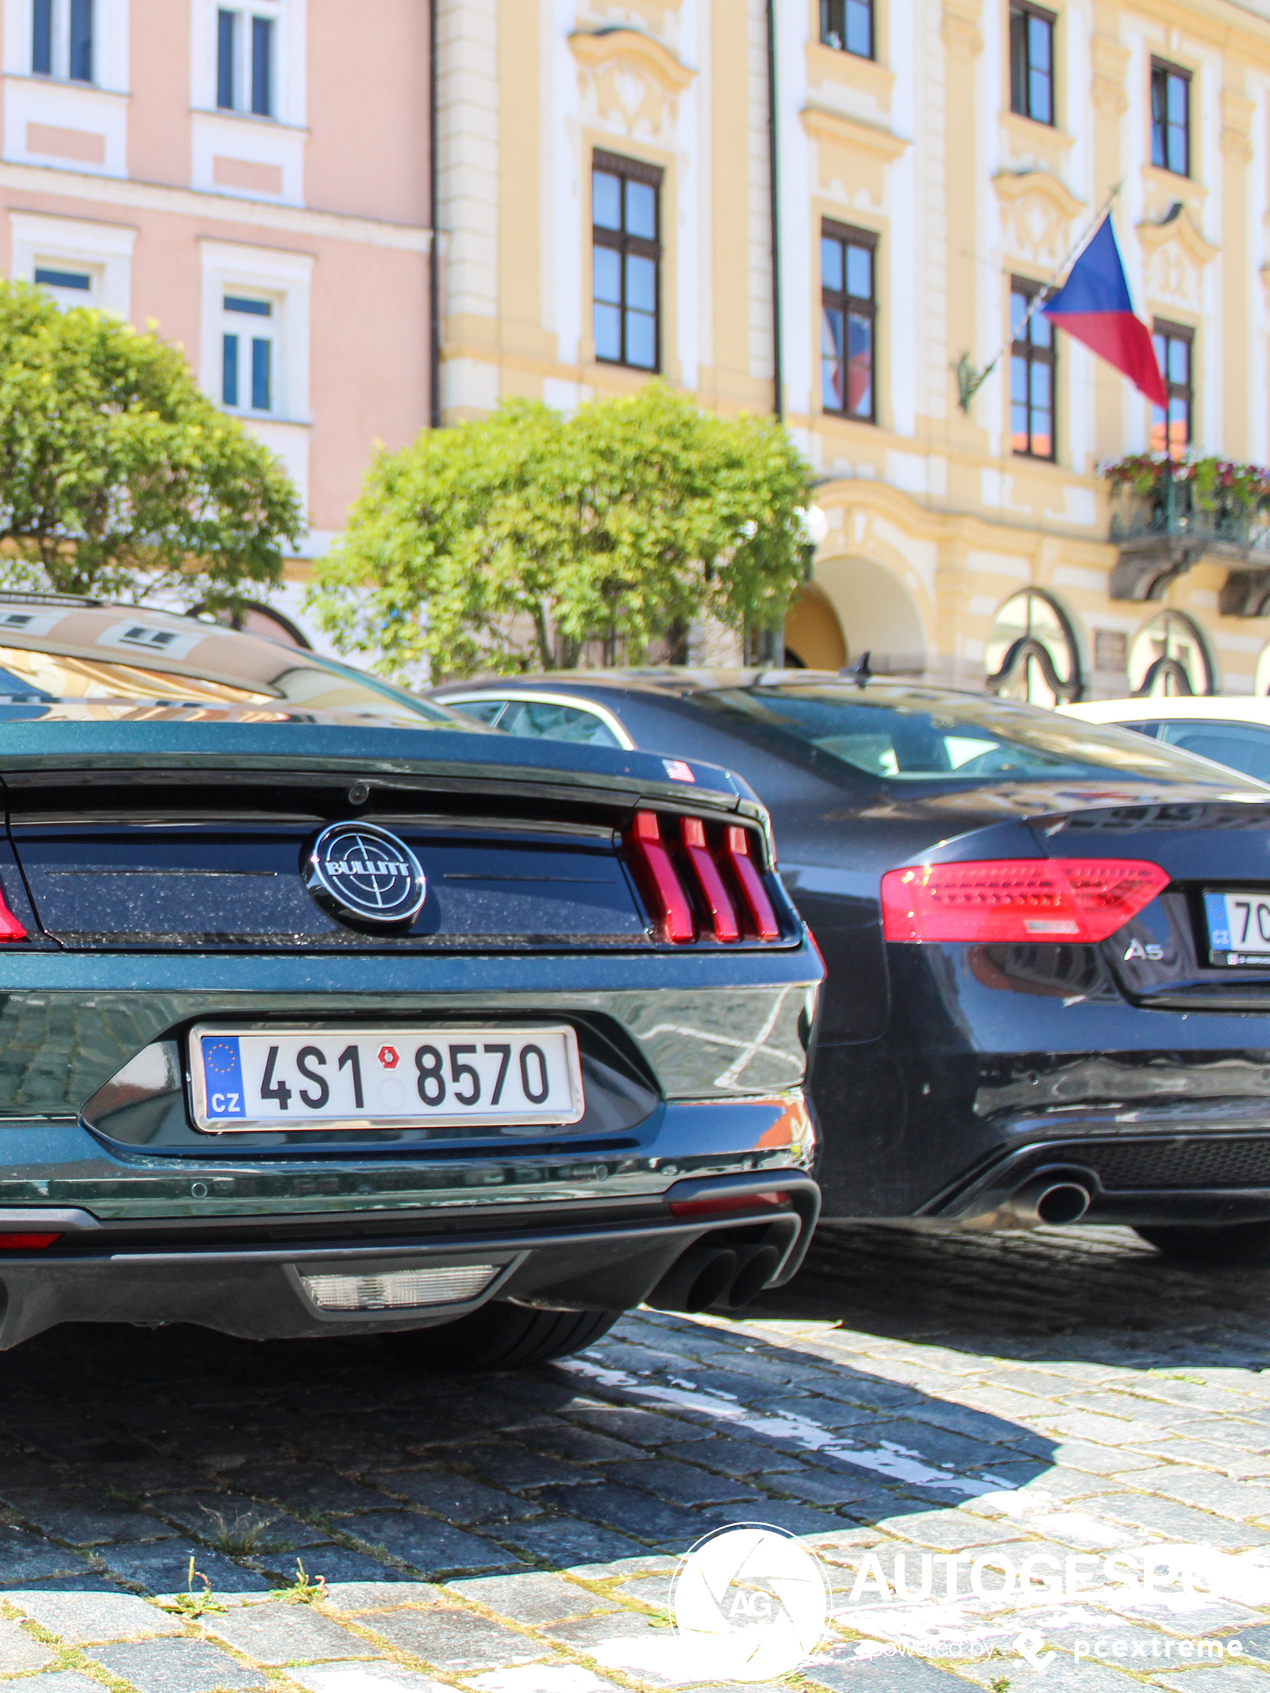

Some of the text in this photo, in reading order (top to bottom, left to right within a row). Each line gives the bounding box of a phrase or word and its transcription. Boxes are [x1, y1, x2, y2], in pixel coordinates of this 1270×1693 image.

[325, 860, 409, 876] BULLITT
[1212, 930, 1229, 944] CZ
[1123, 937, 1164, 961] A5
[260, 1044, 550, 1110] 4S1 8570
[211, 1093, 241, 1113] CZ
